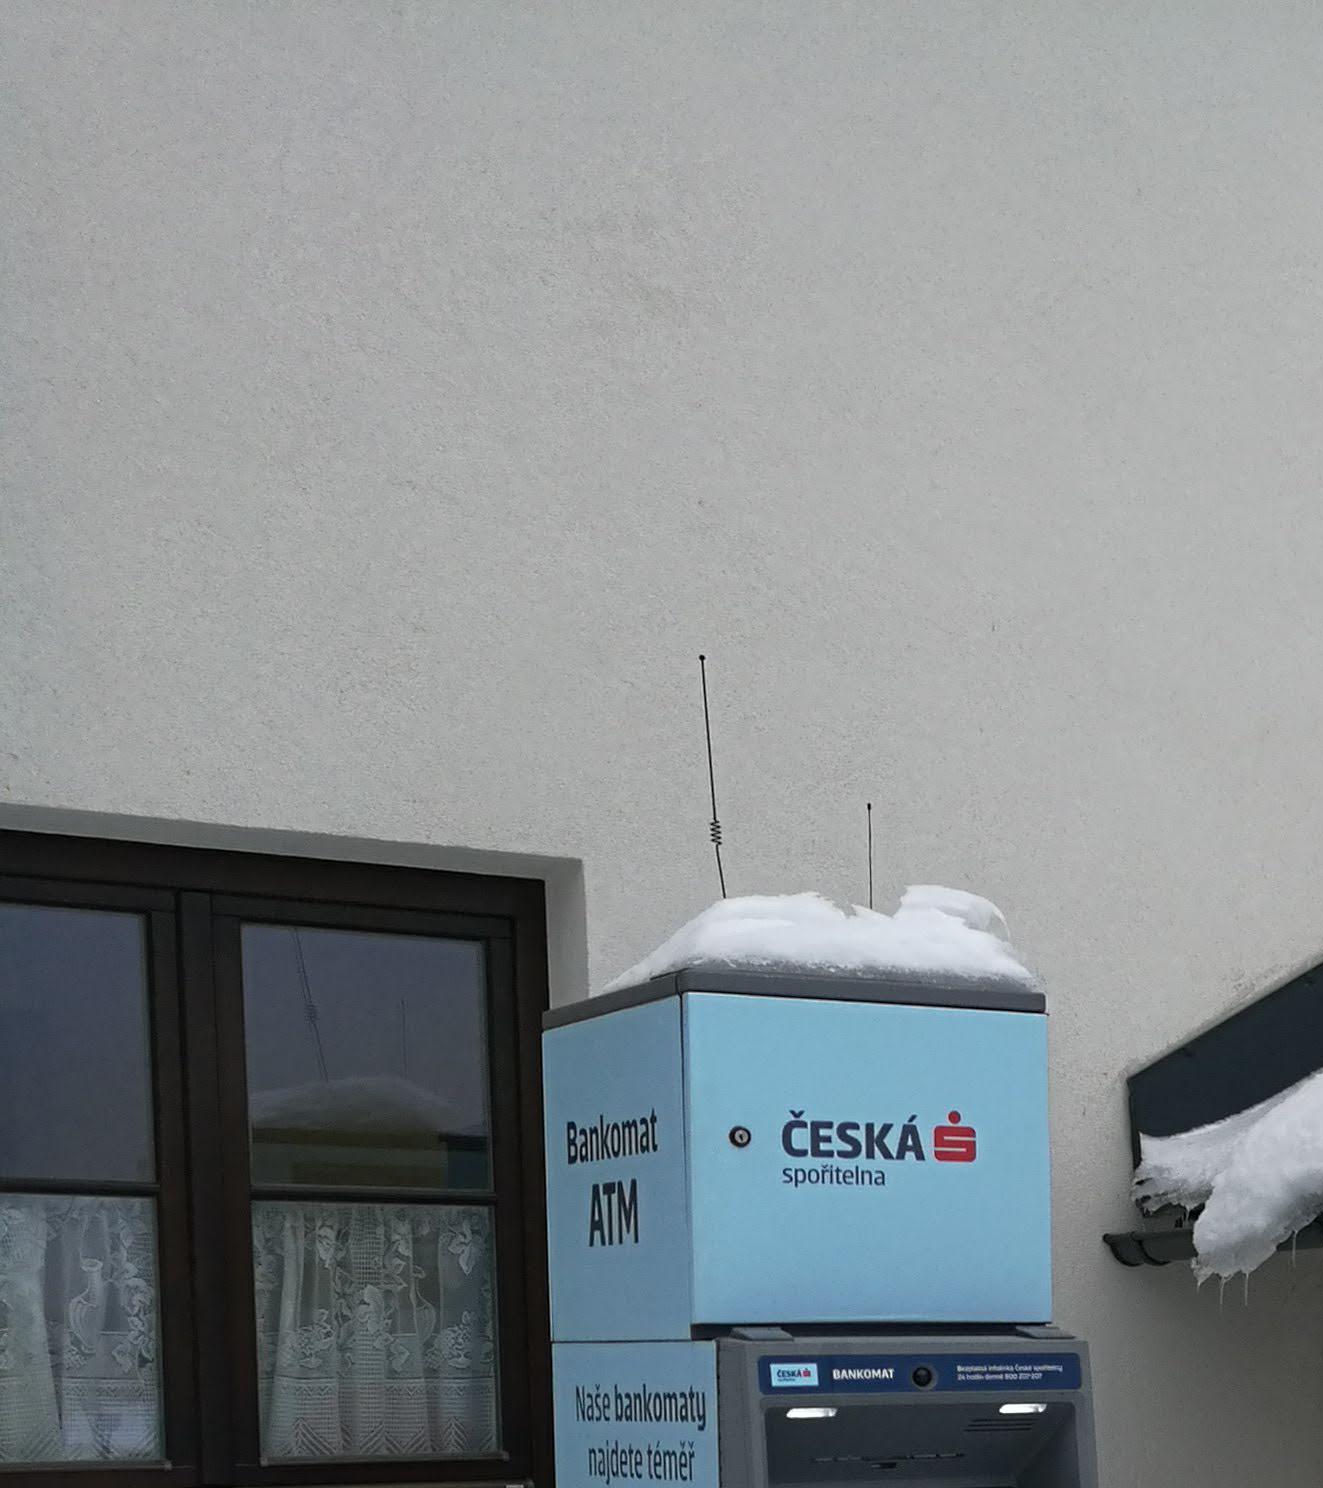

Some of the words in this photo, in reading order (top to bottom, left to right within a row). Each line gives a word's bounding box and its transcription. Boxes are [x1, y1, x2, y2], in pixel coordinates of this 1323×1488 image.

[567, 1109, 659, 1166] Bankomat
[781, 1109, 926, 1162] ČESKÁ
[782, 1164, 887, 1189] spořitelna
[588, 1178, 640, 1248] ATM
[832, 1368, 895, 1381] BANKOMAT
[575, 1383, 611, 1422] Naše
[614, 1383, 707, 1431] bankomaty
[588, 1439, 643, 1485] najdete
[647, 1440, 696, 1482] téměř
